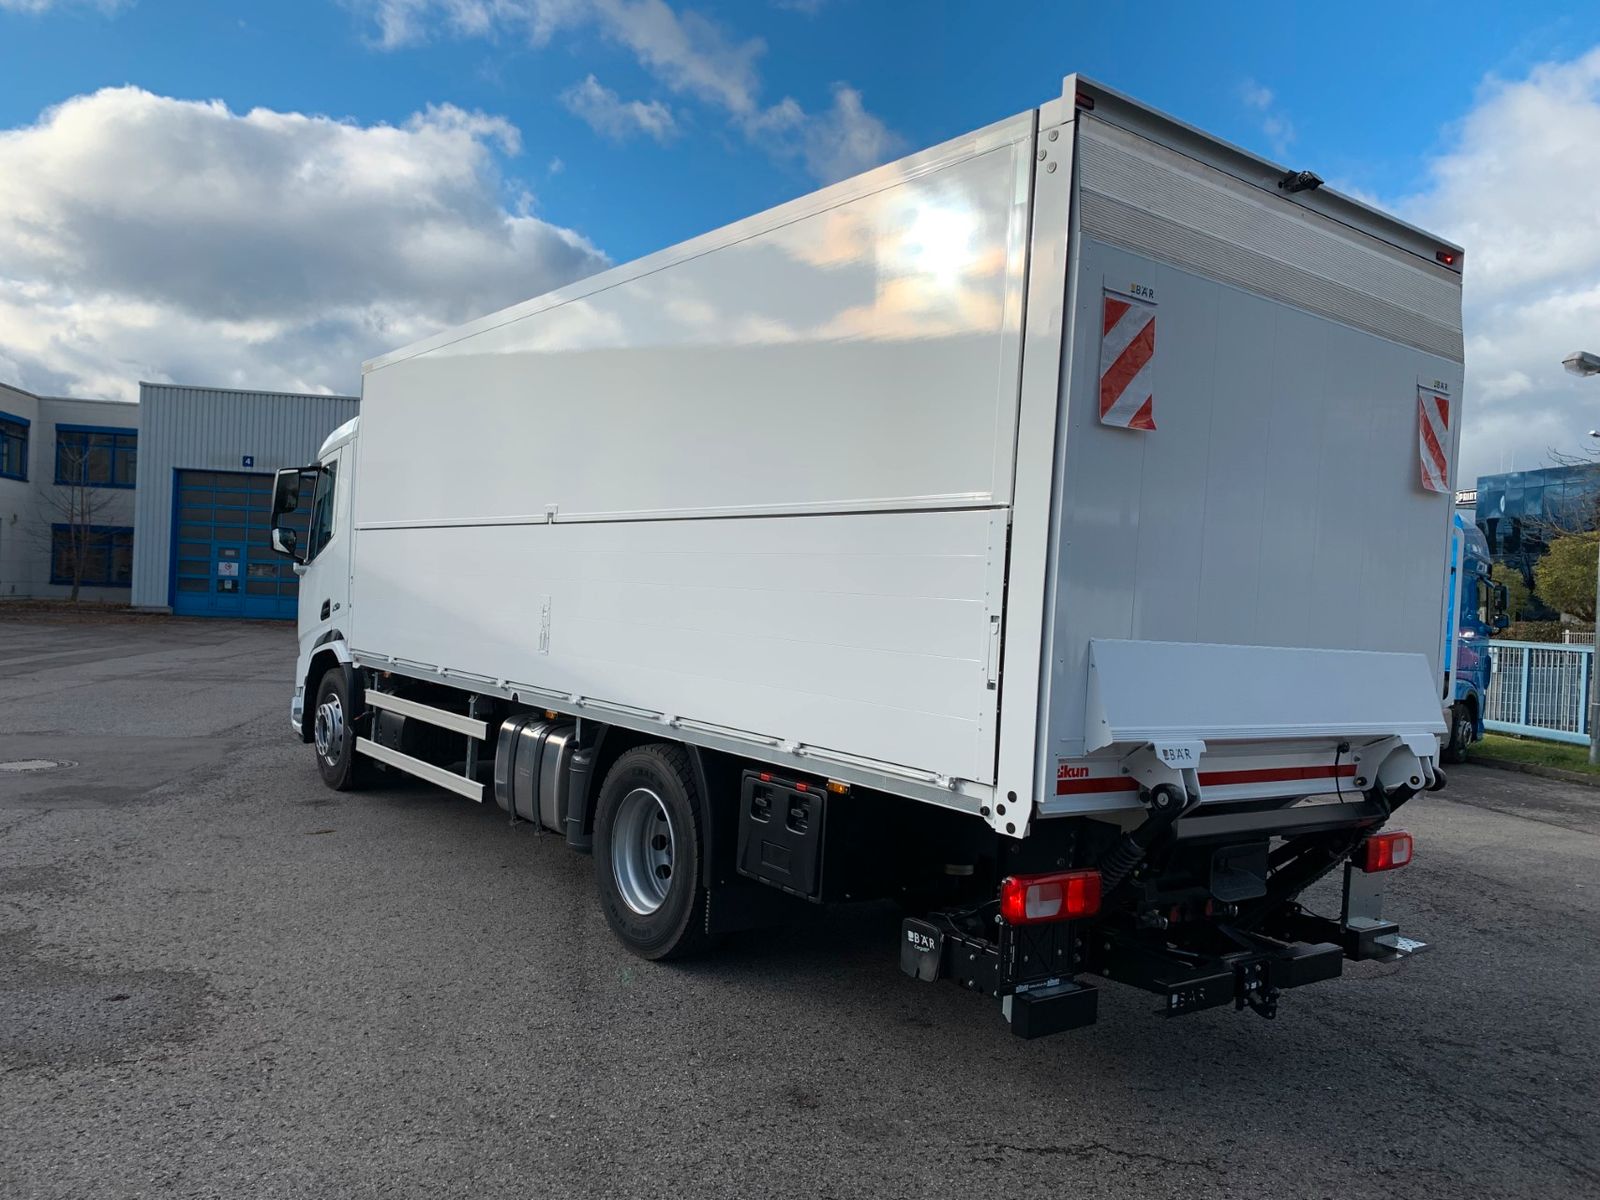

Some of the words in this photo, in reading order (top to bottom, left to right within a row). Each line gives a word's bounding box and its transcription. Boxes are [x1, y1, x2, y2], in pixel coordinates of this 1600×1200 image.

[1136, 284, 1154, 298] BÄR
[1169, 748, 1192, 760] BÄR
[914, 931, 935, 949] BÄR
